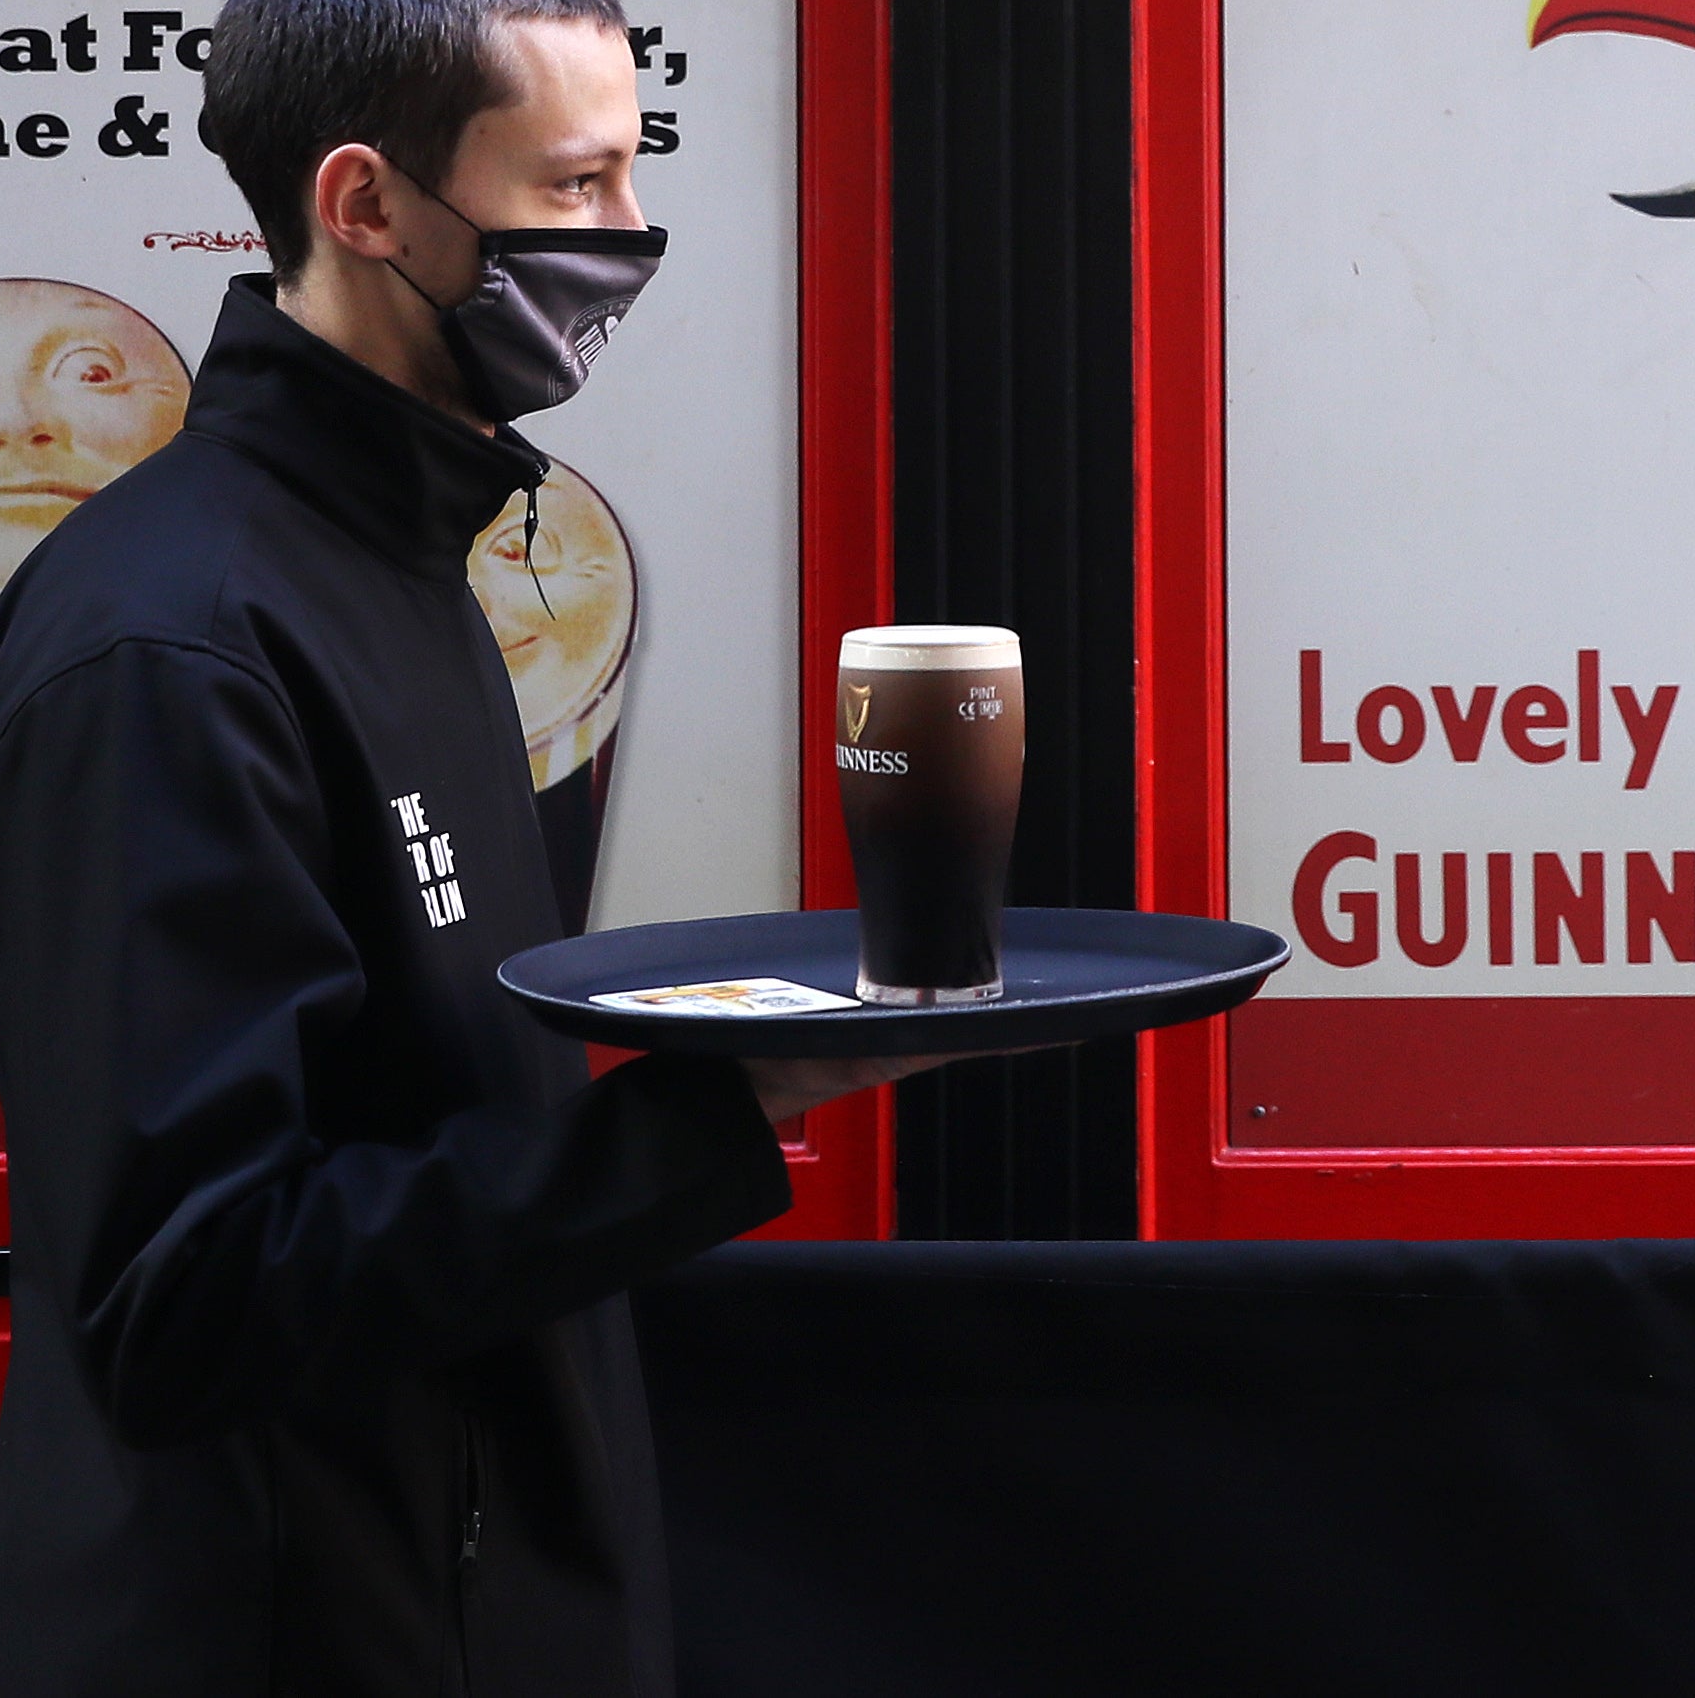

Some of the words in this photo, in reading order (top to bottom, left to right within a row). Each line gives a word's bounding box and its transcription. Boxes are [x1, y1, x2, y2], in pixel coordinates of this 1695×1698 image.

[98, 95, 169, 157] &
[969, 685, 997, 700] PINT
[1300, 649, 1680, 790] Lovely
[390, 792, 430, 838] HE
[428, 832, 456, 878] OF
